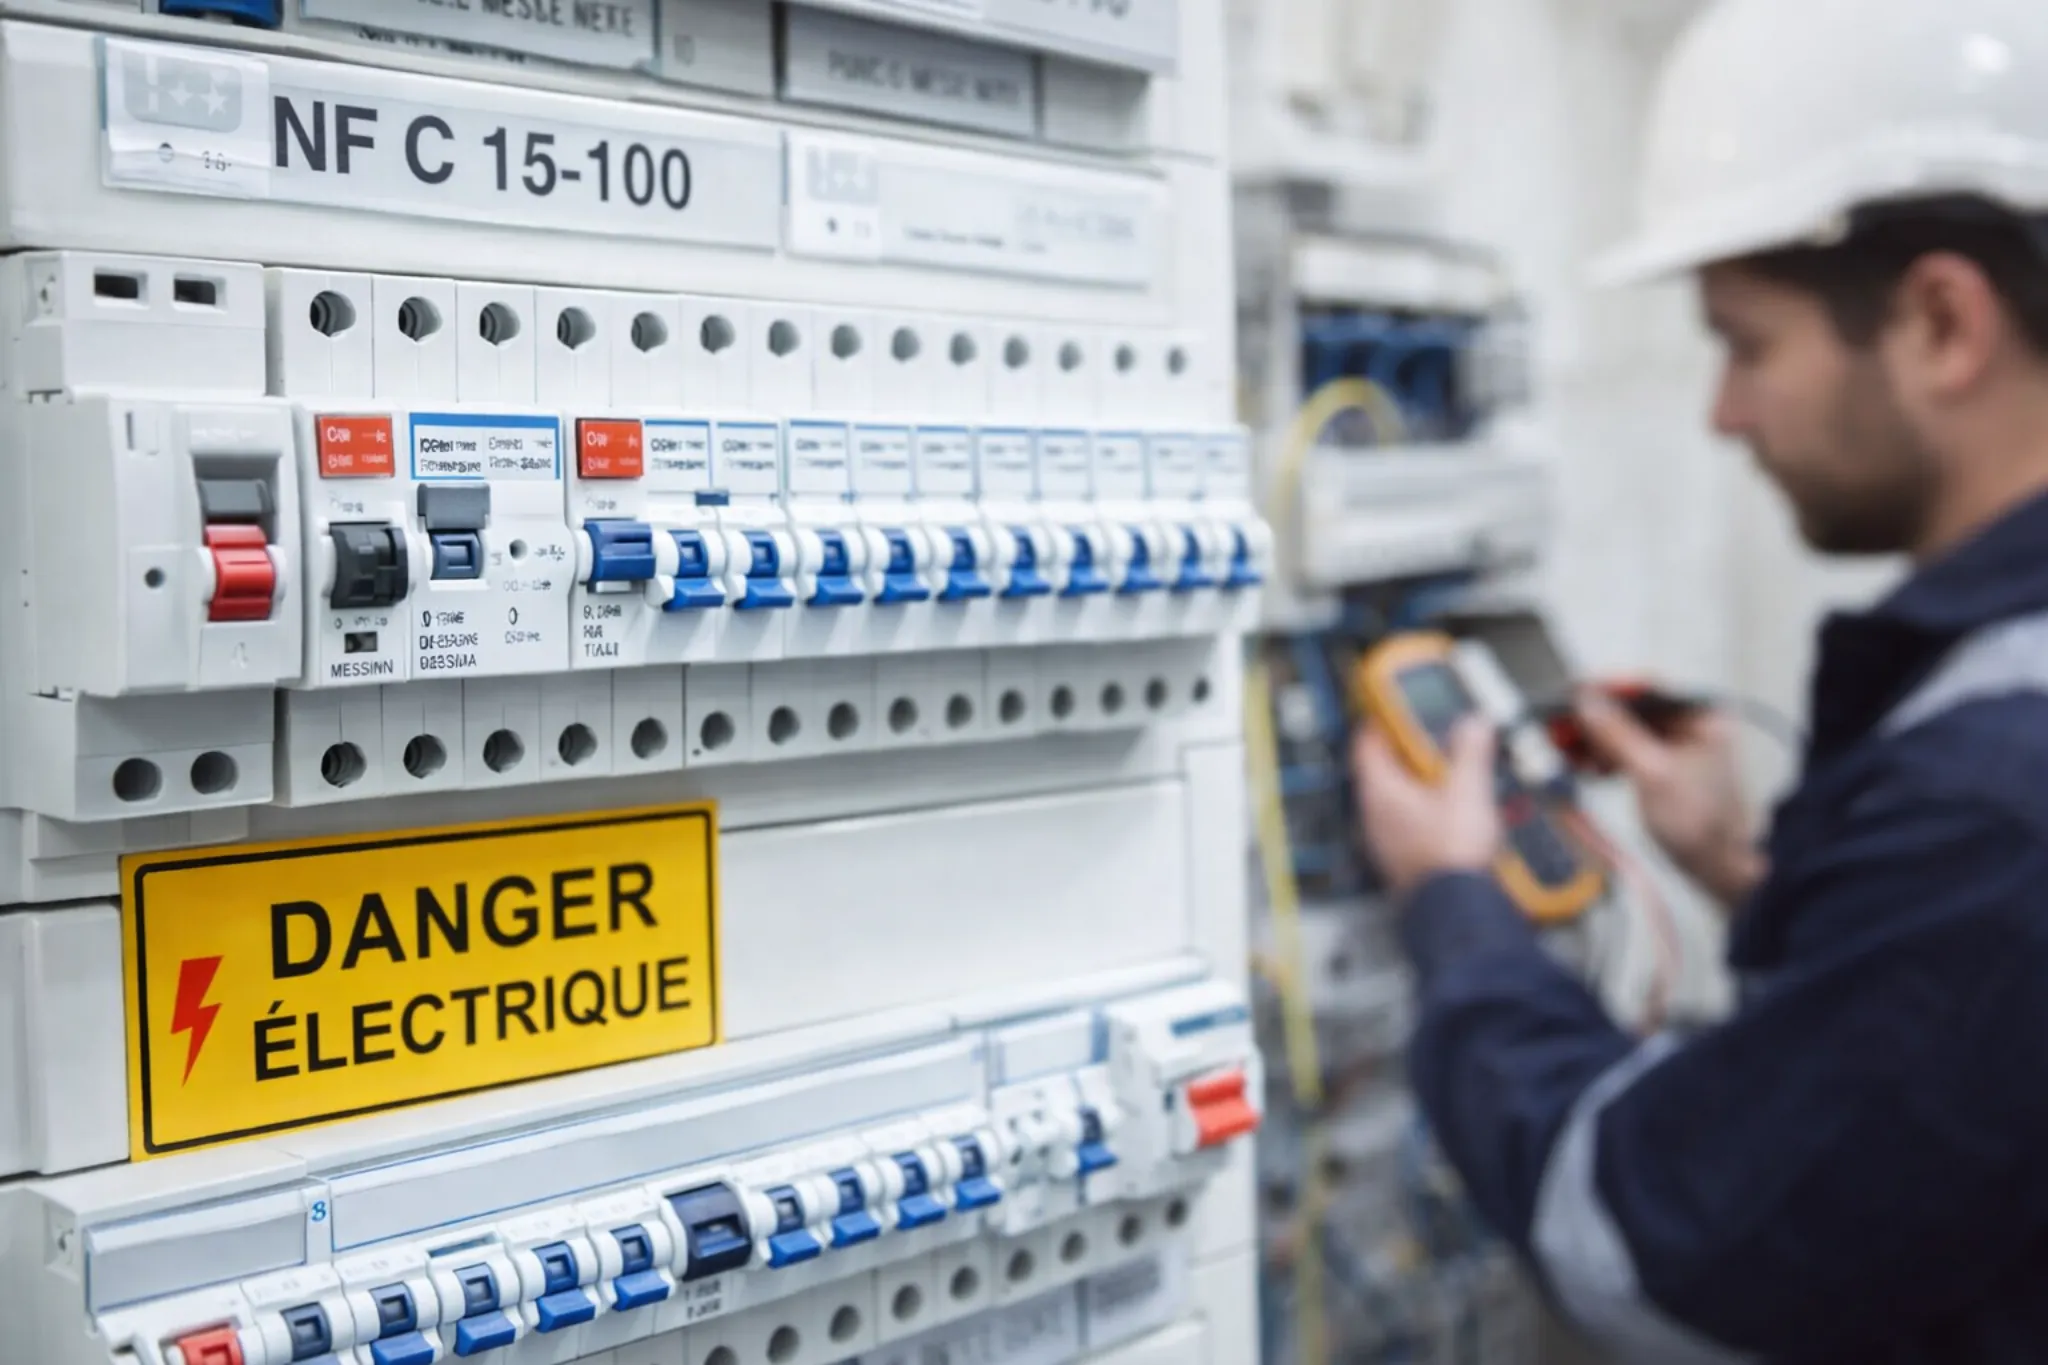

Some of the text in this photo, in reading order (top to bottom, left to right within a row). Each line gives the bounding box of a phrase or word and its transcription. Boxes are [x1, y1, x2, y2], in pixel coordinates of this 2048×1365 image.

[274, 95, 691, 210] NF C 15-100
[270, 862, 658, 980] DANGER
[254, 956, 691, 1082] ÉLECTRIQUE
